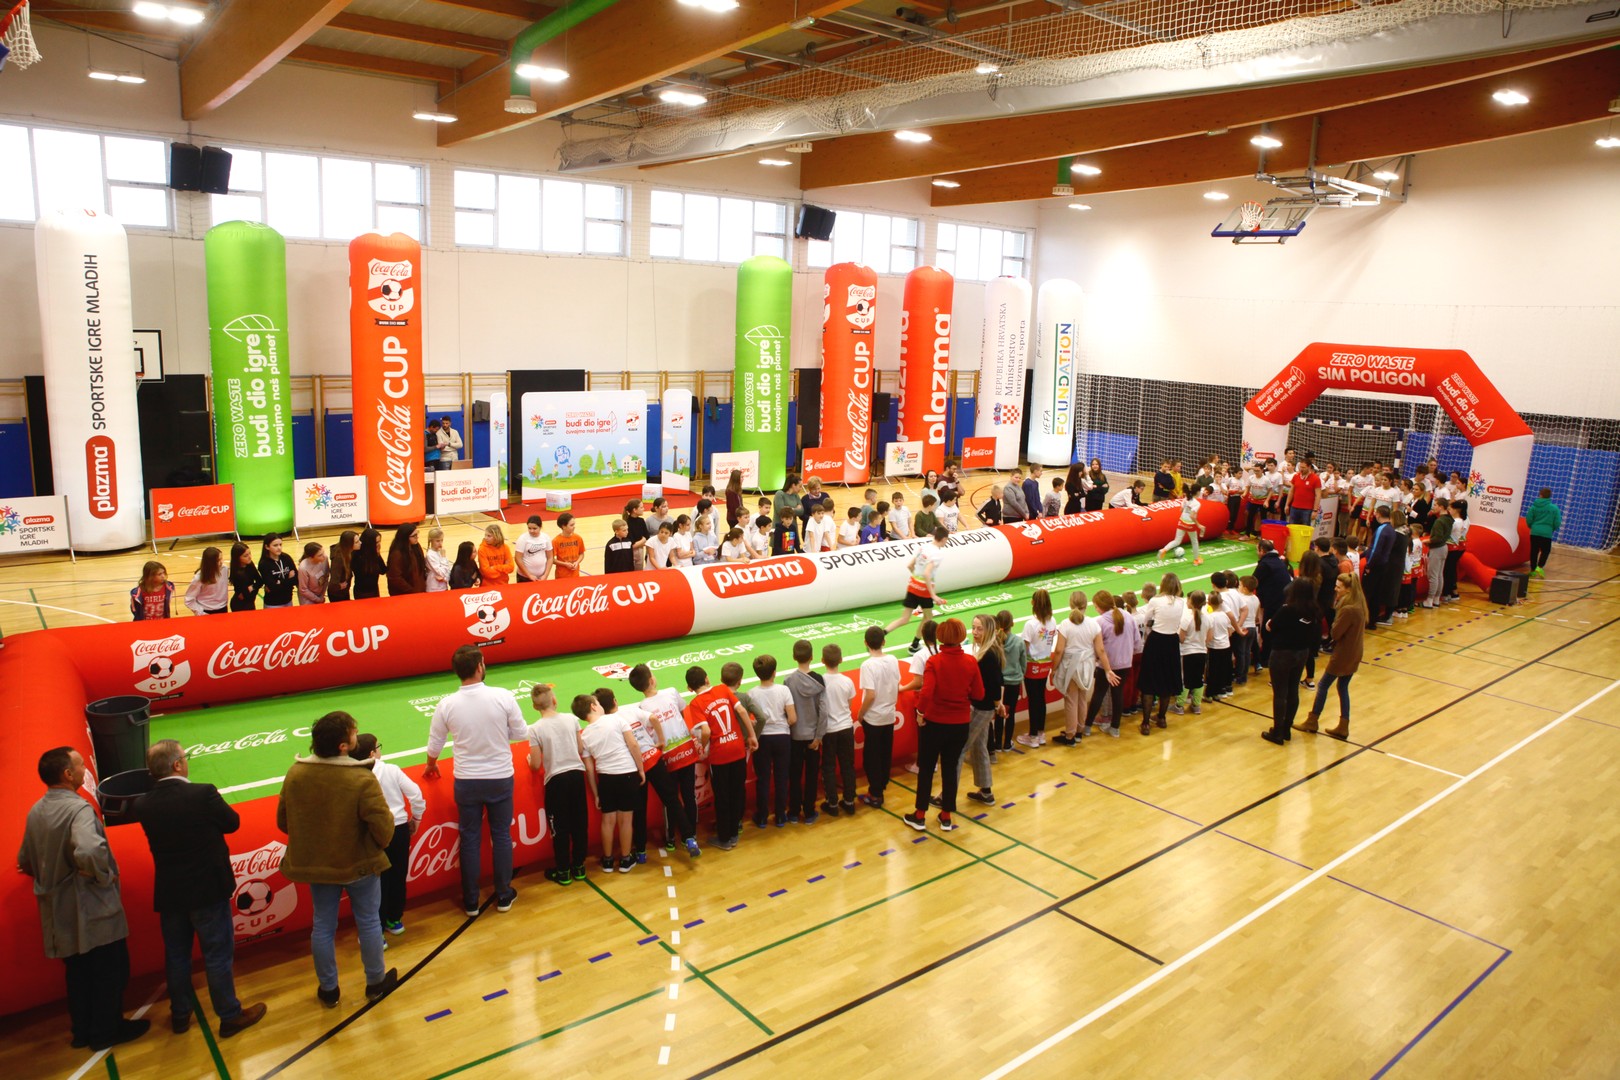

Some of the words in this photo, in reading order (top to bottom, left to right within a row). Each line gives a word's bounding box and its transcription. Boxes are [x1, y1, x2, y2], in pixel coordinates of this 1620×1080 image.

[85, 254, 98, 313] MLADIH
[371, 262, 410, 277] Coca-Cola
[87, 319, 102, 351] IGRE
[998, 302, 1007, 348] HRVATSKA
[243, 333, 268, 373] igre
[266, 334, 281, 375] planet
[383, 336, 409, 398] CUP
[756, 340, 773, 368] igre
[773, 340, 782, 370] planet
[853, 341, 870, 388] CUP
[1005, 333, 1016, 396] Ministarstvo
[1330, 352, 1366, 368] ZERO
[1367, 355, 1416, 370] WASTE
[756, 373, 771, 396] dio
[923, 313, 951, 445] plazma
[995, 348, 1004, 395] REPUBLIKA
[1016, 359, 1024, 397] turizma
[1057, 323, 1072, 436] FOUNDATION
[1318, 366, 1347, 381] SIM
[1350, 368, 1426, 387] POLIGON
[92, 356, 106, 430] SPORTSKE
[228, 378, 243, 423] WASTE
[246, 378, 267, 409] dio
[270, 378, 281, 401] naš
[744, 372, 754, 405] WASTE
[1258, 395, 1274, 412] budi
[1273, 387, 1284, 398] dio
[1282, 375, 1297, 389] igre
[1441, 377, 1461, 398] budi
[1456, 397, 1469, 411] dio
[1466, 409, 1482, 428] igre
[273, 403, 285, 456] čuvajmo
[565, 419, 582, 427] budi
[597, 419, 611, 428] igre
[745, 406, 754, 432] ZERO
[757, 400, 771, 433] budi
[845, 388, 869, 470] Coca-Cola
[1042, 409, 1051, 435] UEFA
[233, 424, 249, 458] ZERO
[249, 414, 272, 458] budi
[377, 398, 413, 506] Coca-Cola
[93, 447, 115, 512] plazma
[441, 488, 458, 496] budi
[473, 486, 487, 495] igre
[178, 506, 211, 517] Coca-Cola
[211, 505, 230, 514] CUP
[1479, 506, 1504, 514] MLADIH
[1481, 494, 1512, 503] SPORTSKE
[25, 516, 50, 524] plazma
[1040, 513, 1085, 531] Coca-Cola
[1080, 511, 1104, 522] CUP
[713, 557, 804, 594] plazma
[819, 545, 906, 570] SPORTSKE
[464, 592, 498, 605] Coca-Cola
[522, 583, 608, 625] Coca-Cola
[612, 581, 661, 607] CUP
[478, 625, 500, 634] CUP
[135, 639, 180, 657] Coca-Cola
[207, 627, 324, 679] Coca-Cola
[326, 624, 390, 657] CUP
[646, 650, 715, 670] Coca-Cola
[715, 644, 755, 656] CUP
[149, 680, 177, 690] CUP
[711, 704, 732, 735] 17
[650, 747, 658, 756] CUP
[684, 748, 694, 757] CUP
[235, 913, 277, 932] CUP
